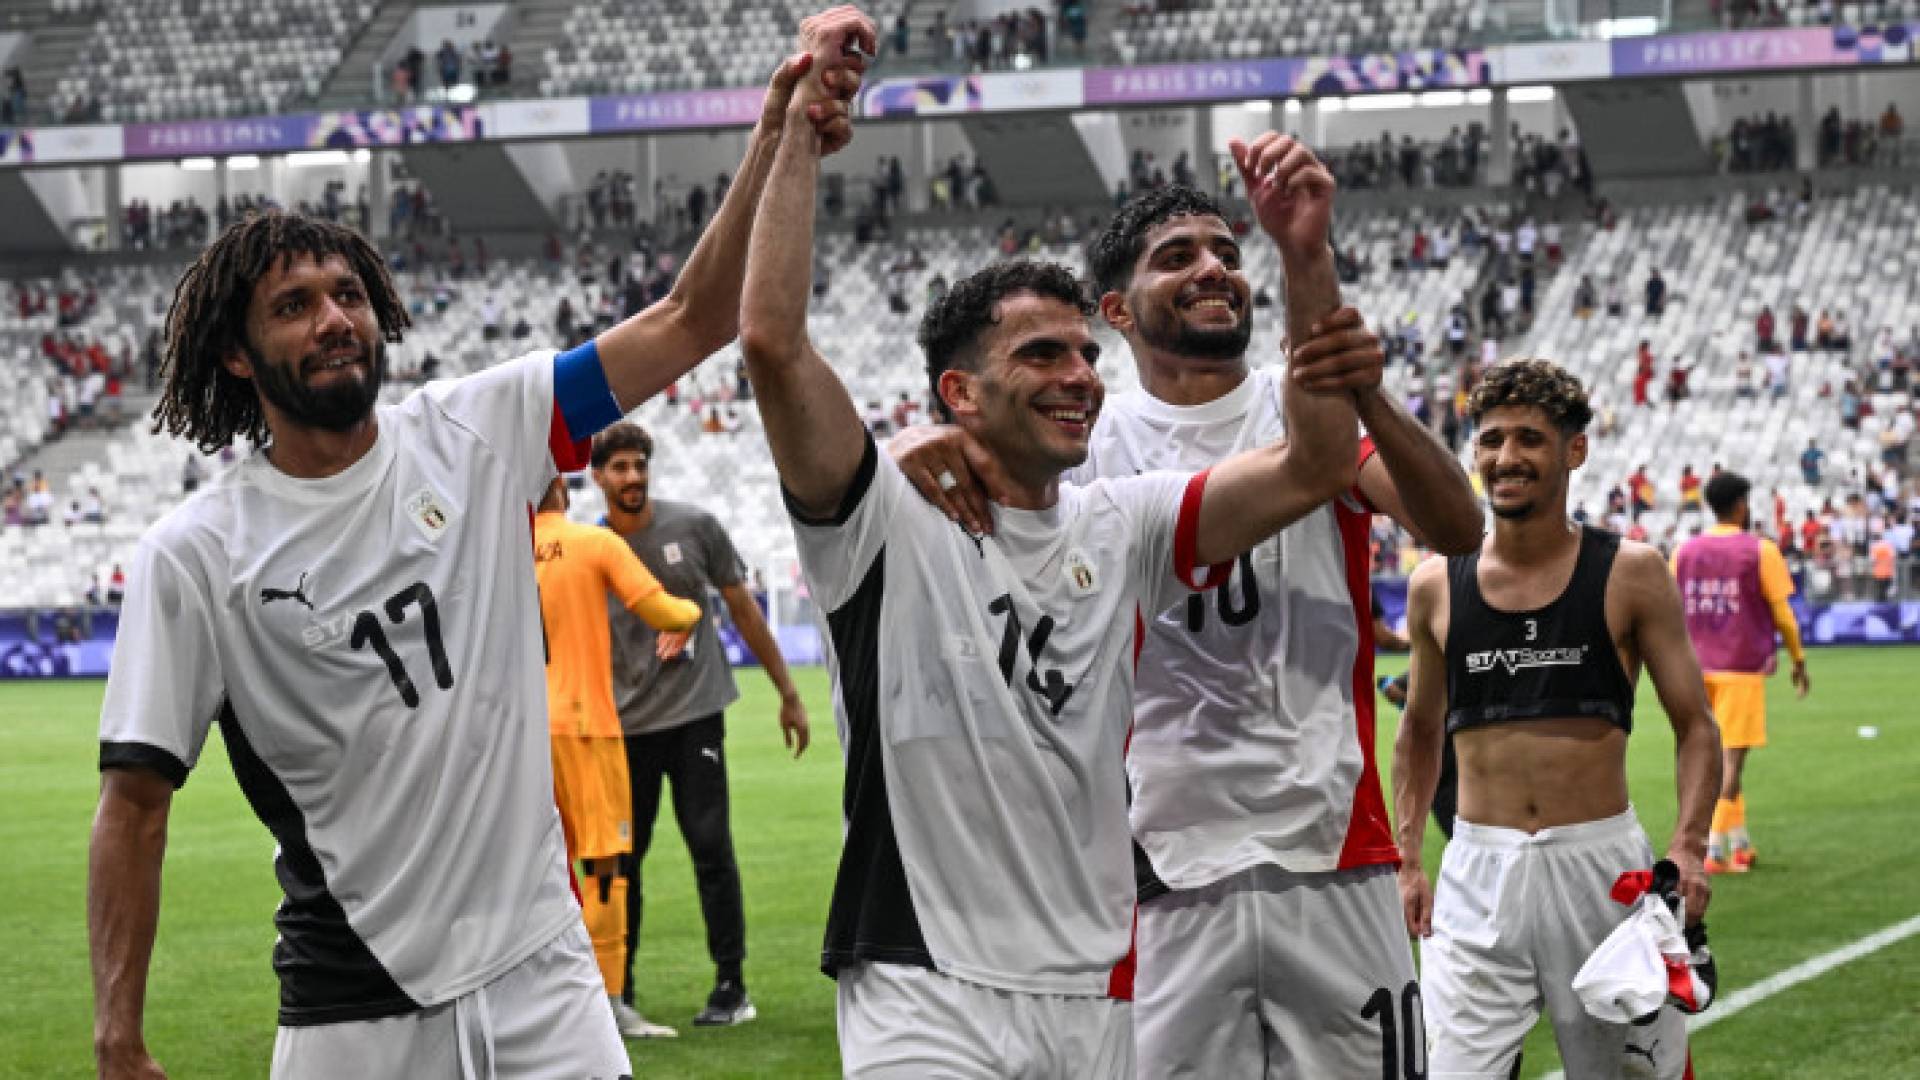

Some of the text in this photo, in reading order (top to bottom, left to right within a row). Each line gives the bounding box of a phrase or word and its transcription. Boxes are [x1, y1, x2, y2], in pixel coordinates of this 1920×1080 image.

[1642, 40, 1721, 64] PARIS
[1112, 69, 1263, 93] PARIS 2024
[616, 99, 687, 121] PARIS
[149, 126, 215, 147] PARIS
[1525, 618, 1538, 641] 3
[350, 580, 454, 709] 17
[988, 593, 1075, 716] 14
[1360, 980, 1428, 1080] 10
